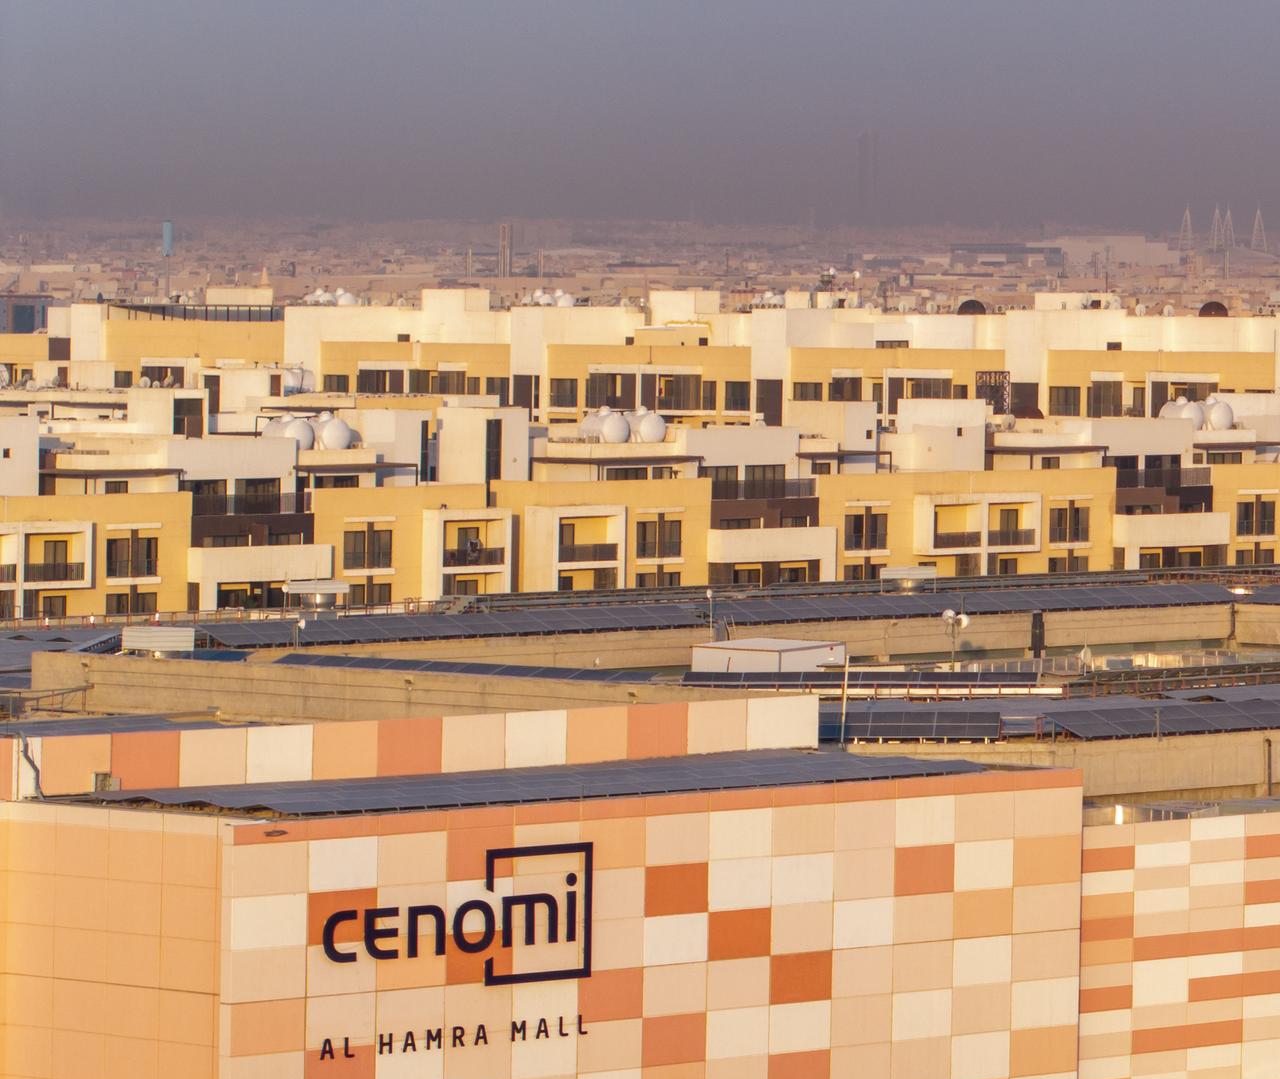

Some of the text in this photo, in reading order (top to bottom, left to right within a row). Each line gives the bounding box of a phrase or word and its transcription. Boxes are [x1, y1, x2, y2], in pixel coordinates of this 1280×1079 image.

[319, 1014, 590, 1060] AL HAMRA MALL
